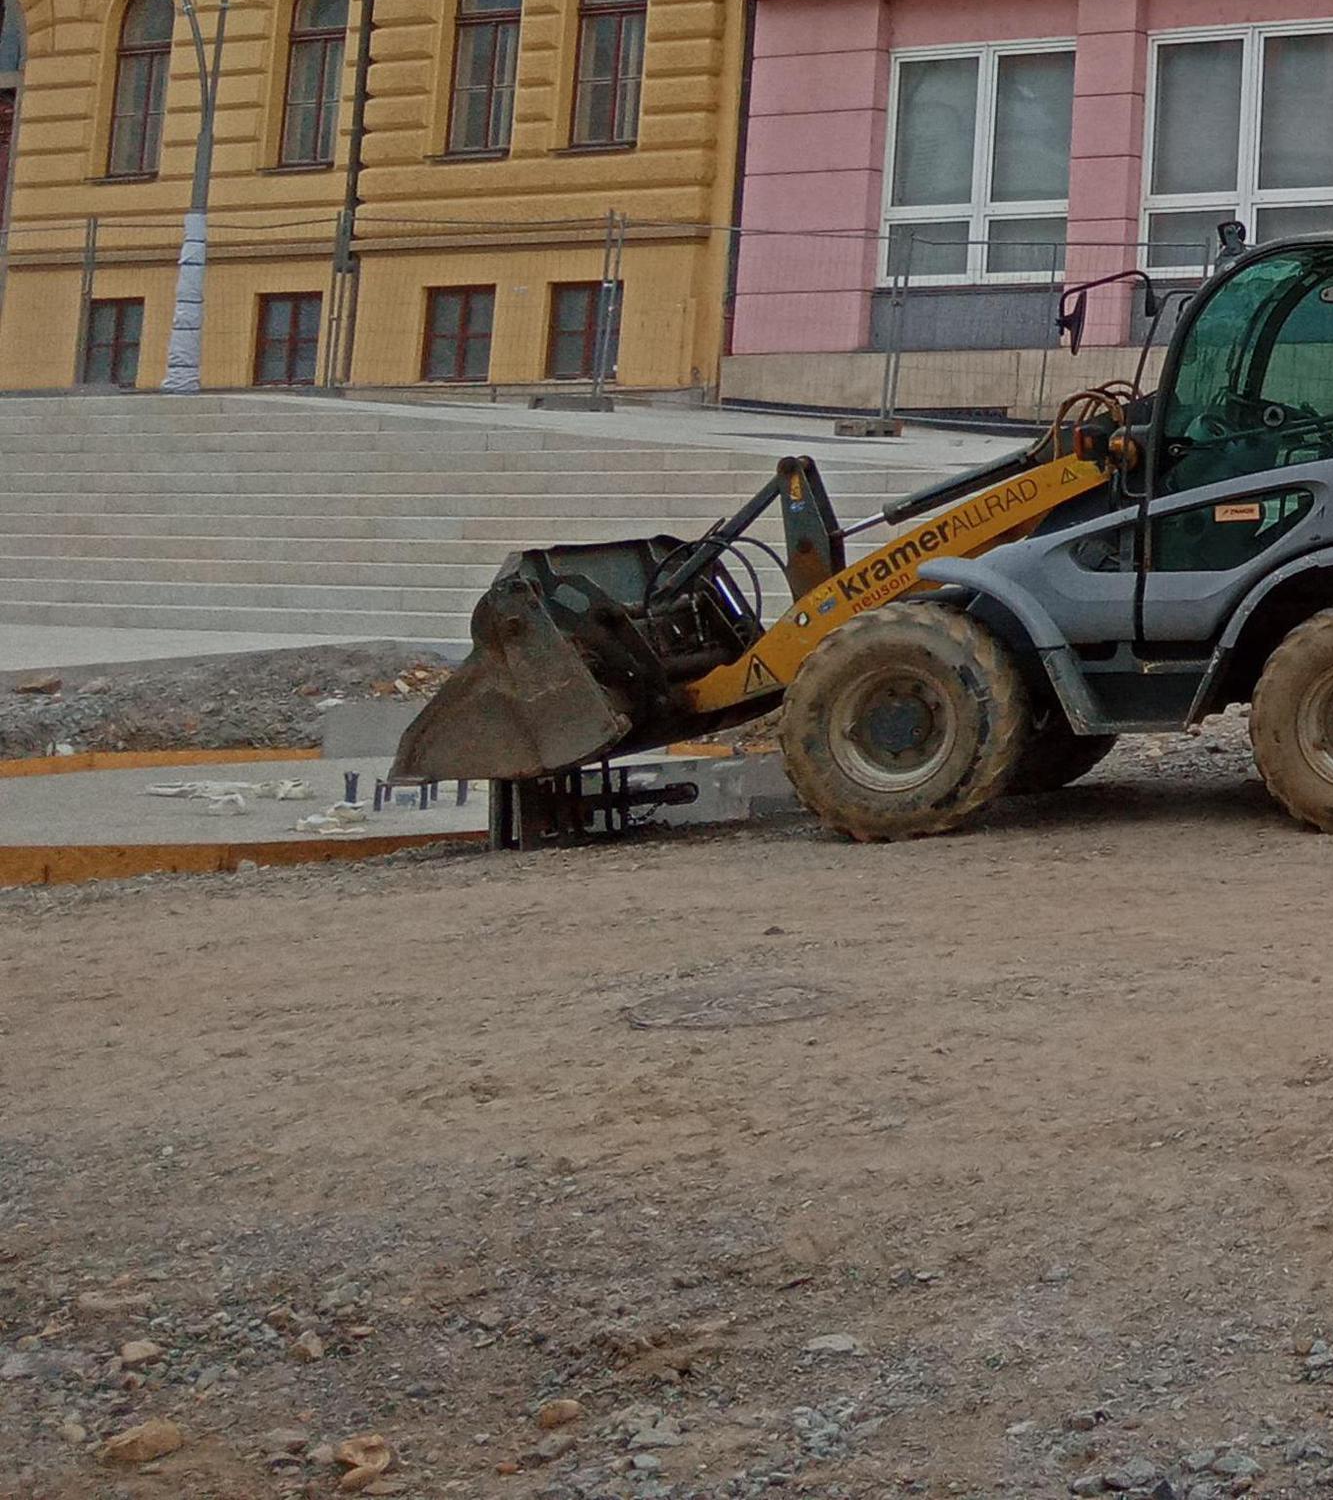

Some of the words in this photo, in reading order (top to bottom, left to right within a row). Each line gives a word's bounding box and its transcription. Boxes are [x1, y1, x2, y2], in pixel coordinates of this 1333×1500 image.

[837, 519, 951, 601] kramer
[950, 478, 1038, 537] ALLRAD
[851, 571, 912, 615] neuson
